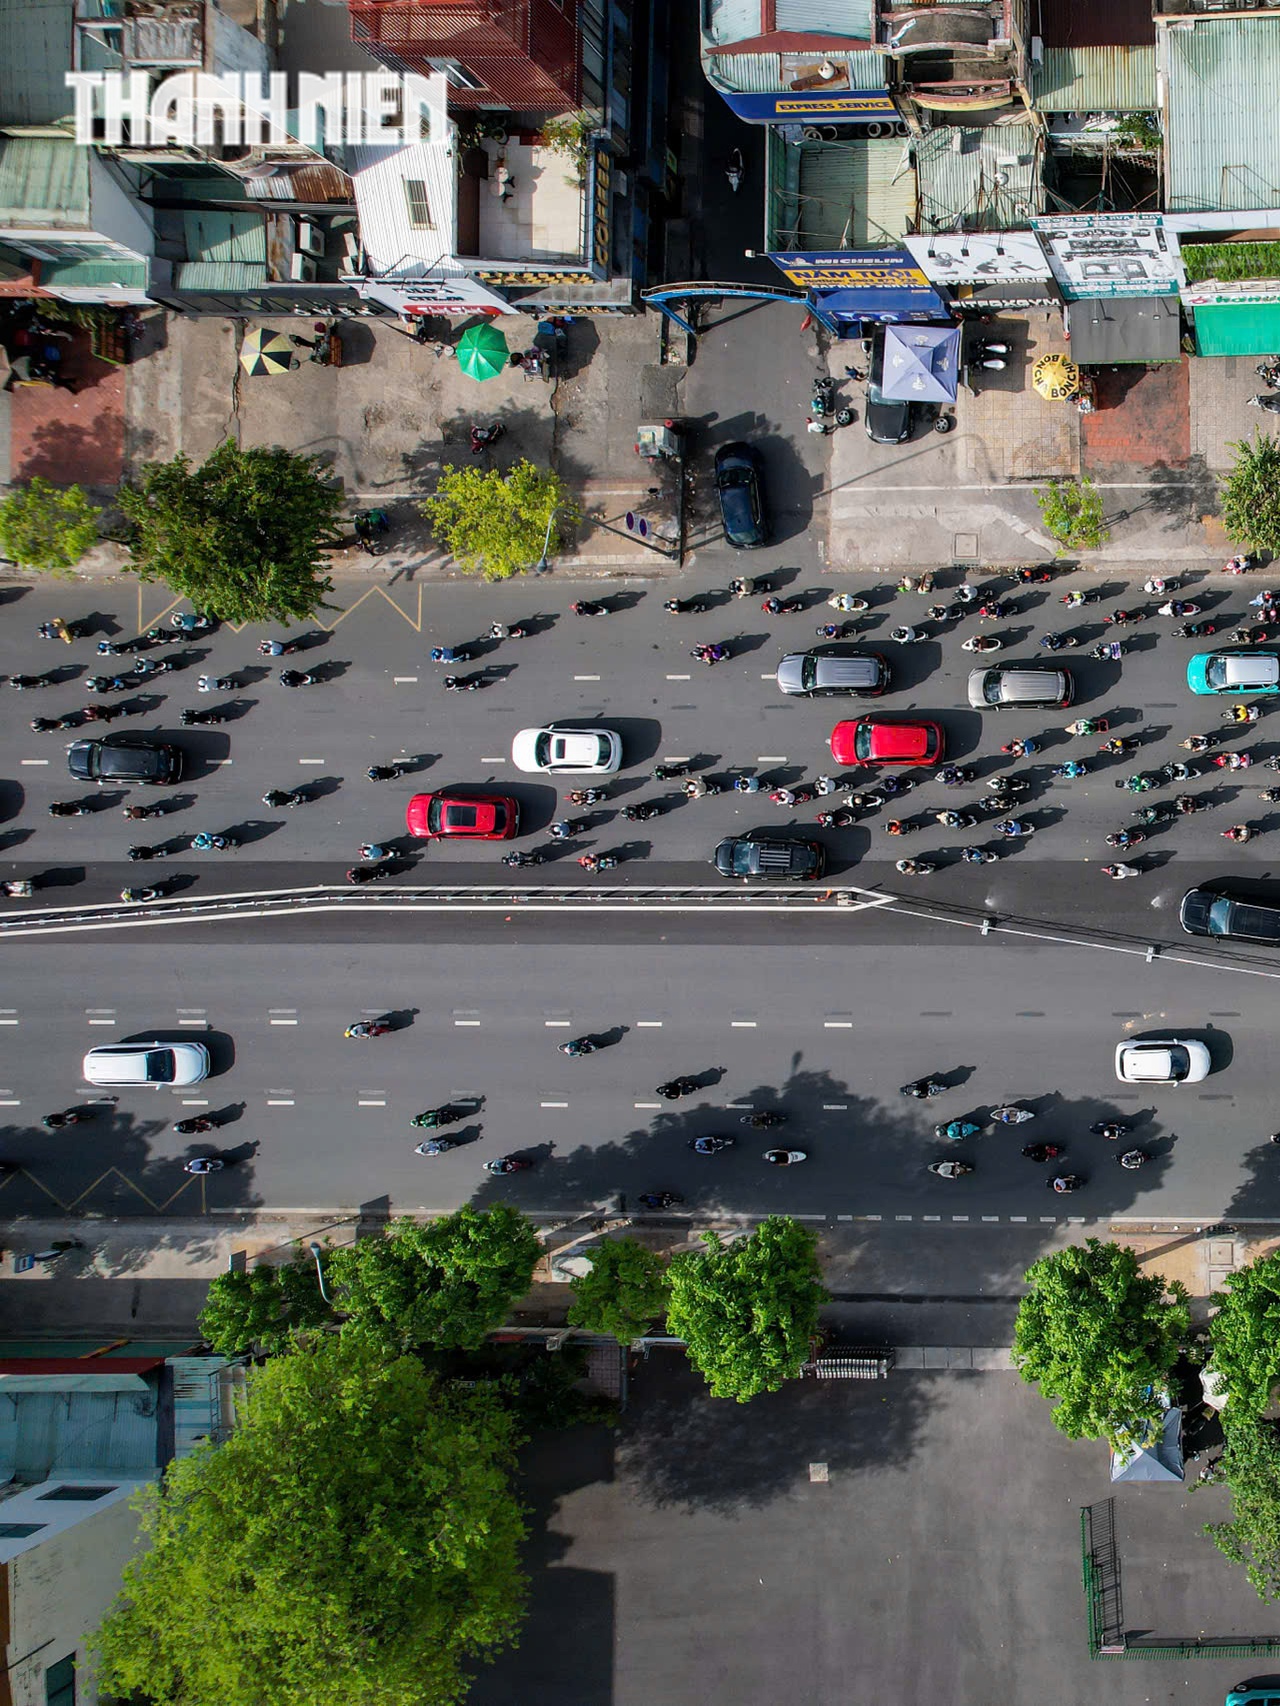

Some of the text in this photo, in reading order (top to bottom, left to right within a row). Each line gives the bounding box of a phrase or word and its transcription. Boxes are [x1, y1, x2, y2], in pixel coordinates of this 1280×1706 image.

[838, 101, 892, 109] SERVICE
[595, 150, 610, 266] COFFEE
[936, 278, 1048, 286] GYM-BOXING
